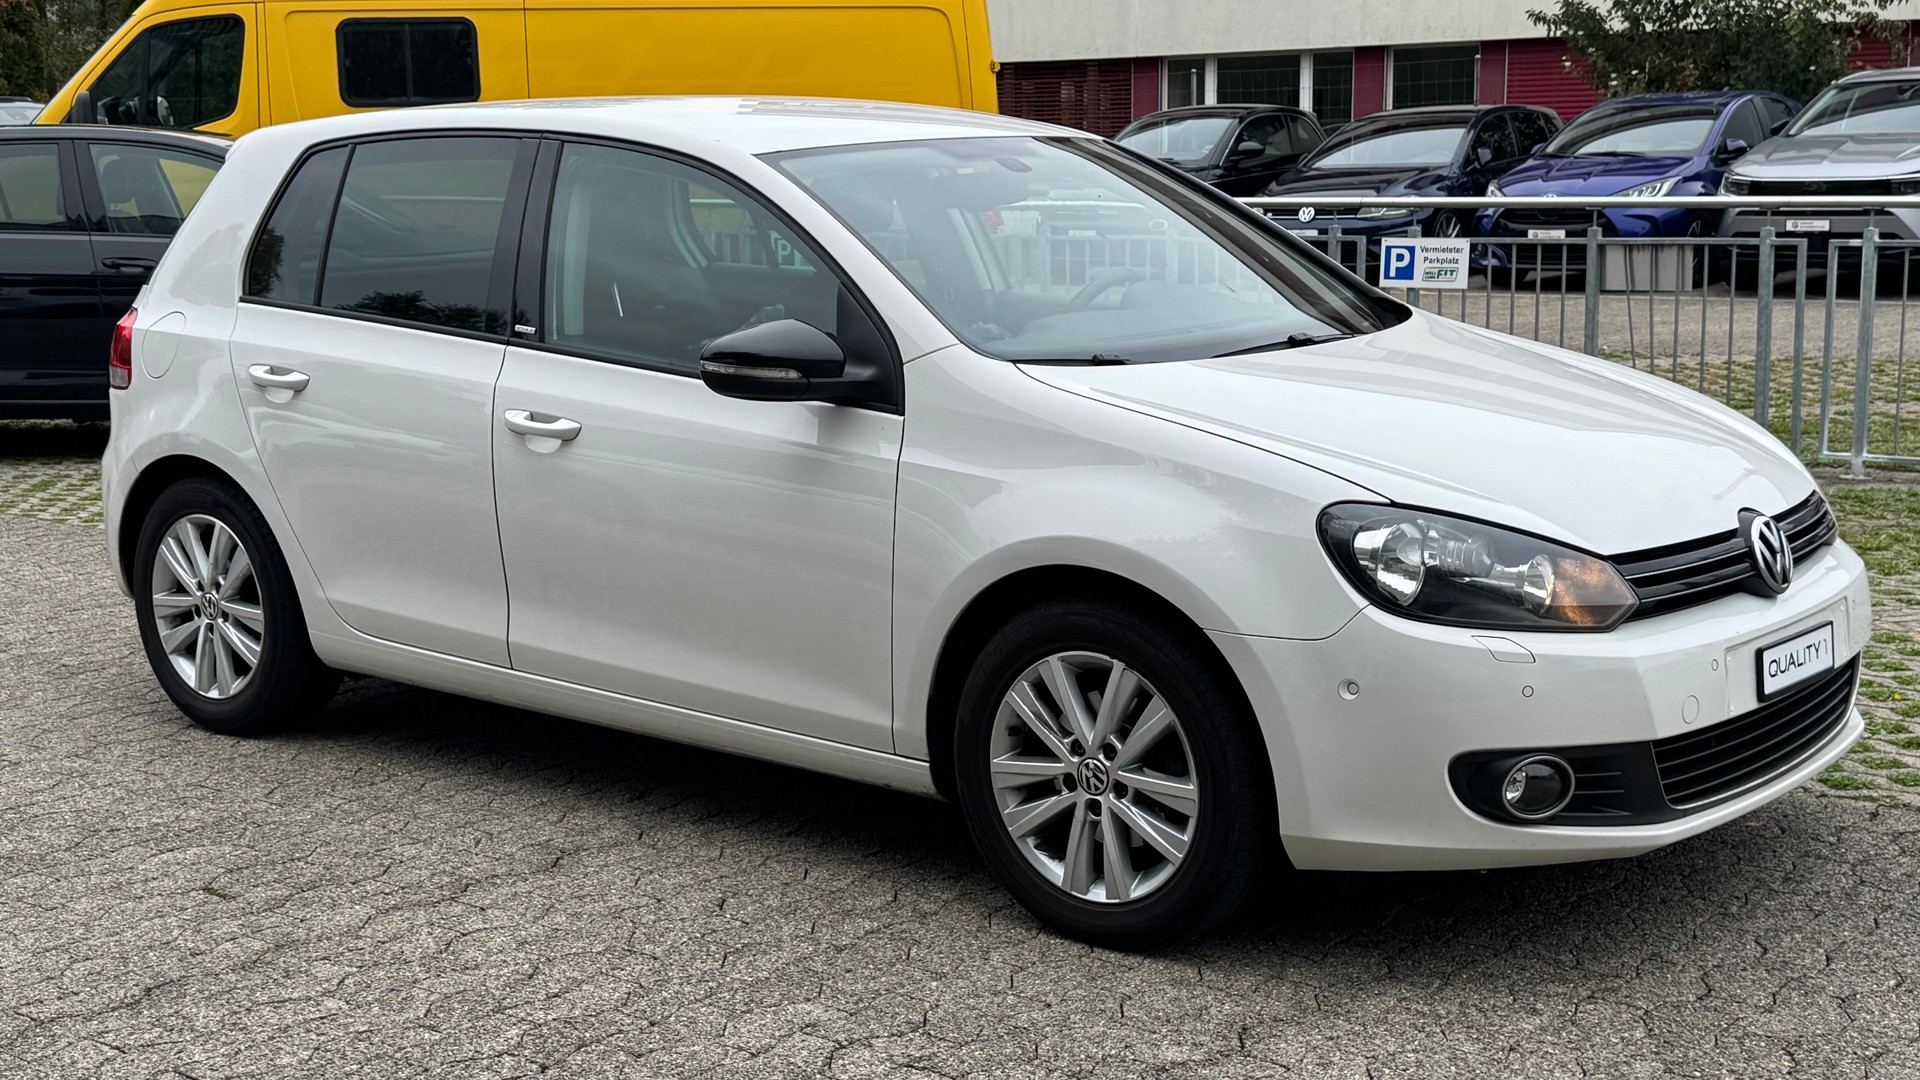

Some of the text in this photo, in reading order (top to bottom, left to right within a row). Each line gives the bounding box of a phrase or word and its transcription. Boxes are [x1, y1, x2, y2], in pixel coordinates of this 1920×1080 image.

[1420, 245, 1464, 254] Vermieteter
[1389, 248, 1411, 278] P
[1423, 256, 1459, 265] Parkplatz
[1436, 269, 1457, 279] FIT
[1768, 640, 1821, 678] QUALITY
